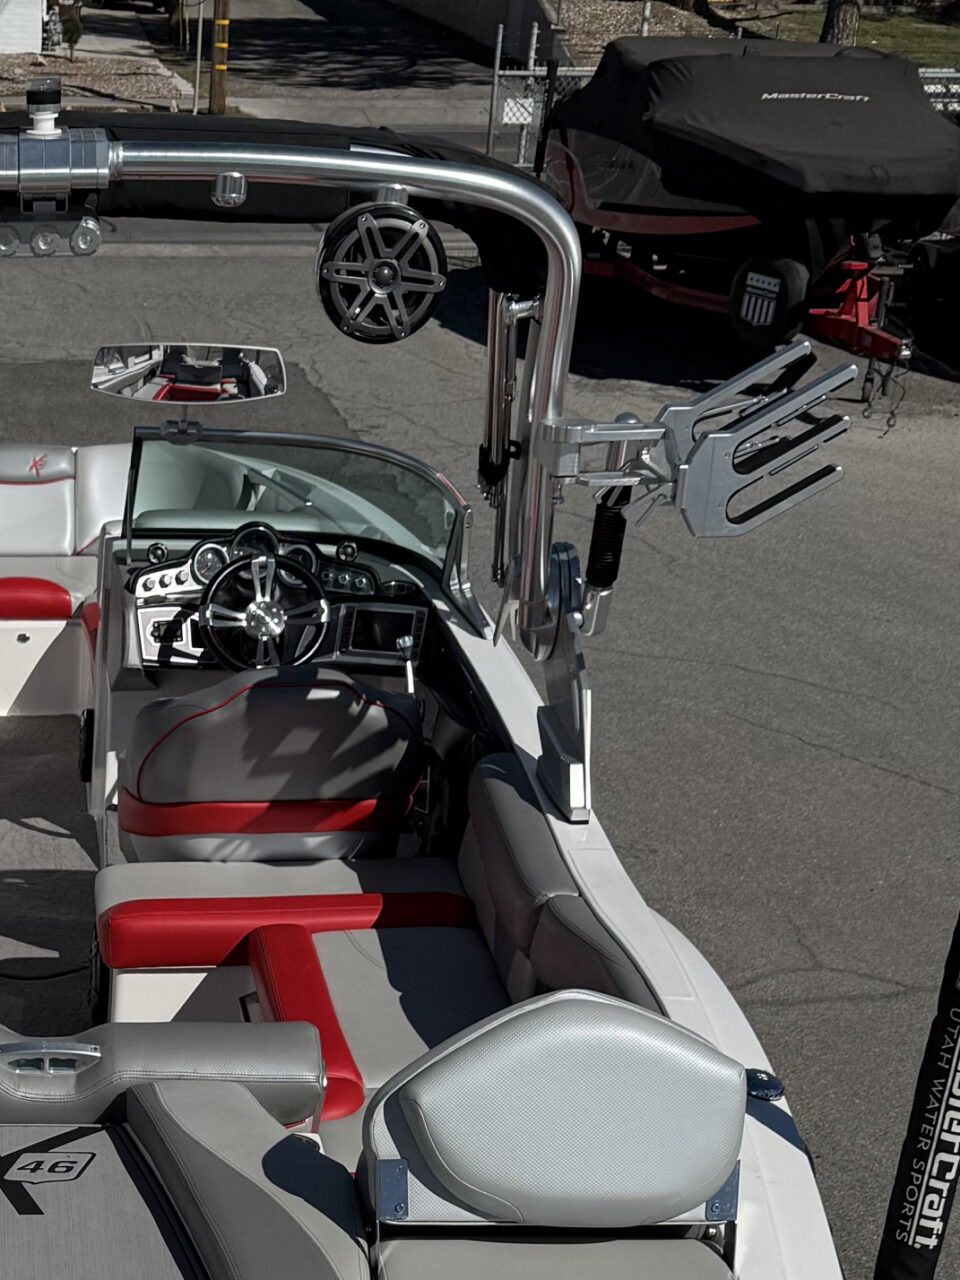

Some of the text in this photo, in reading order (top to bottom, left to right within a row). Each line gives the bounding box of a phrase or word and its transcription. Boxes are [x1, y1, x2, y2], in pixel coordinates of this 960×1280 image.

[761, 92, 870, 102] MasterCraft
[895, 1007, 960, 1243] UTAH WATER SPORTS
[16, 1160, 78, 1174] 46
